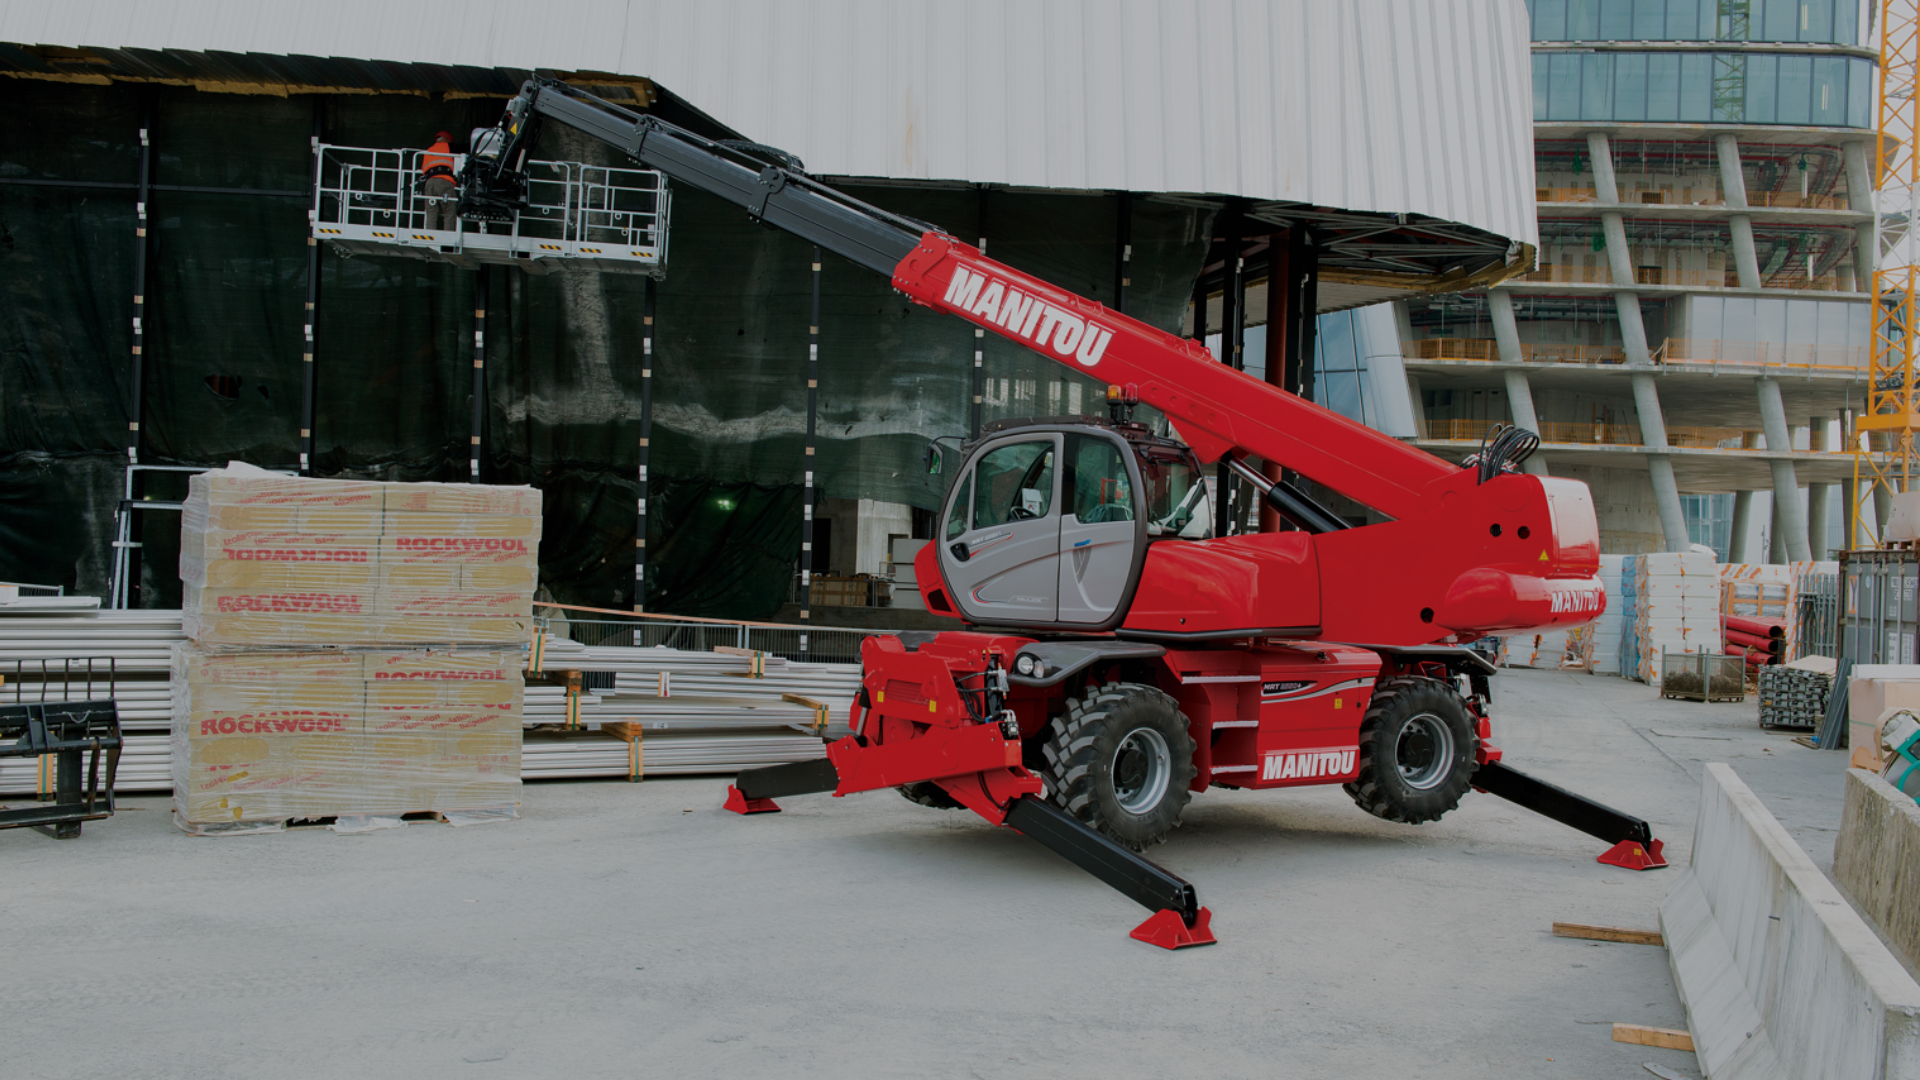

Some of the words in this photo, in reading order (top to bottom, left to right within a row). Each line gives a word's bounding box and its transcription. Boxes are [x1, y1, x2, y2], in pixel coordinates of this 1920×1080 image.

[944, 264, 1115, 367] MANITOU
[395, 537, 527, 552] ROCKWOOL
[217, 593, 362, 613] ROCKWOOL
[1551, 591, 1600, 613] MANITOU
[200, 715, 347, 735] ROCKWOOL
[1262, 751, 1355, 780] MANITOU
